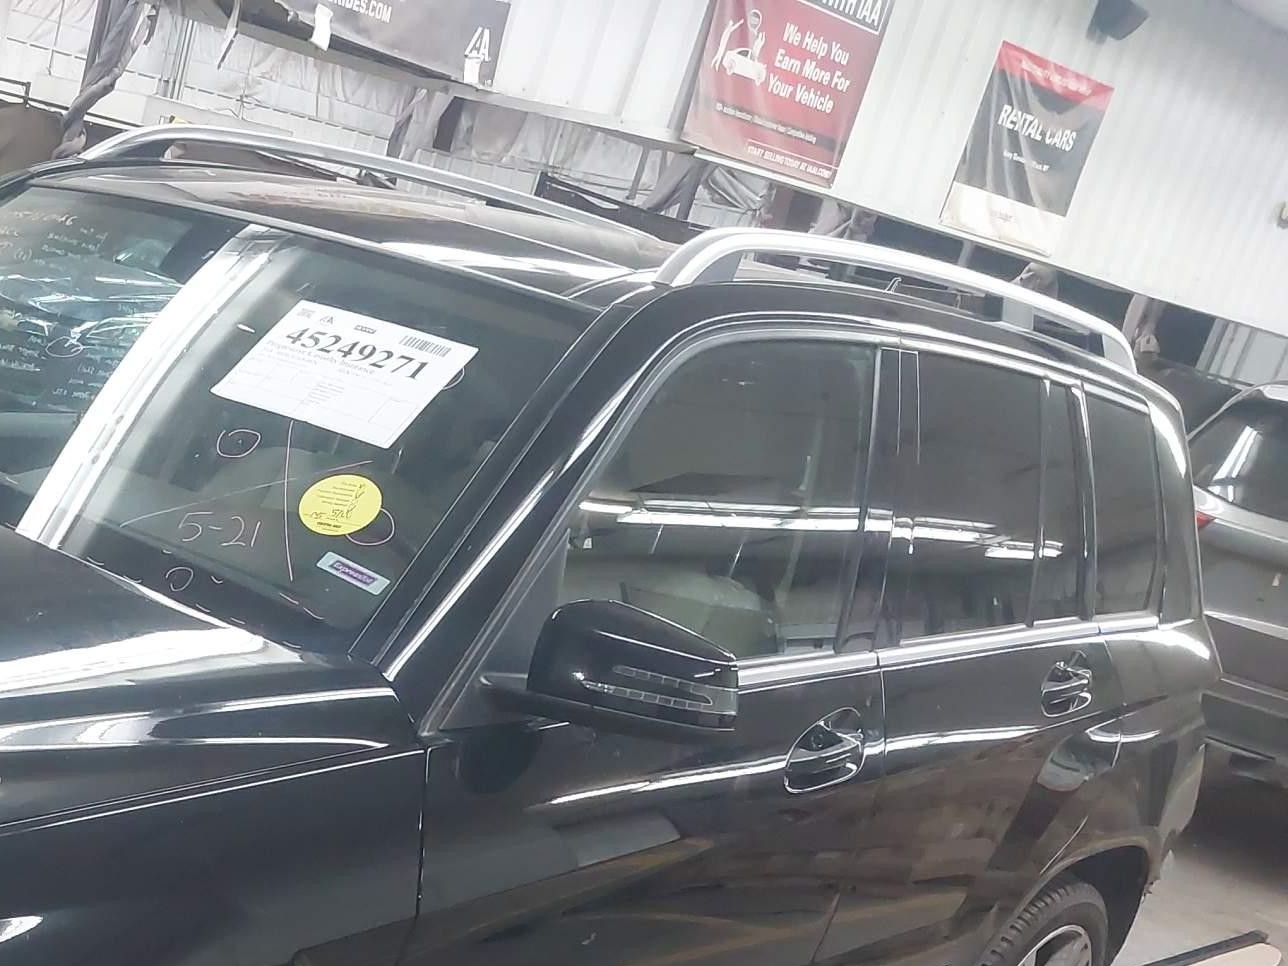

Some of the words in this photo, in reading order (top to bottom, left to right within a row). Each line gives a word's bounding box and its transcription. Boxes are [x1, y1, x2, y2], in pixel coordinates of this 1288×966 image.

[783, 22, 801, 46] We
[802, 31, 828, 59] Help
[830, 41, 850, 65] You
[774, 49, 801, 74] Earn
[801, 59, 831, 86] More
[831, 71, 850, 92] For
[768, 73, 794, 98] Your
[795, 83, 834, 113] Vehicle
[998, 104, 1043, 141] RENTAL
[1045, 128, 1077, 152] CARS
[286, 327, 429, 380] 45249271
[179, 512, 261, 547] 5-21
